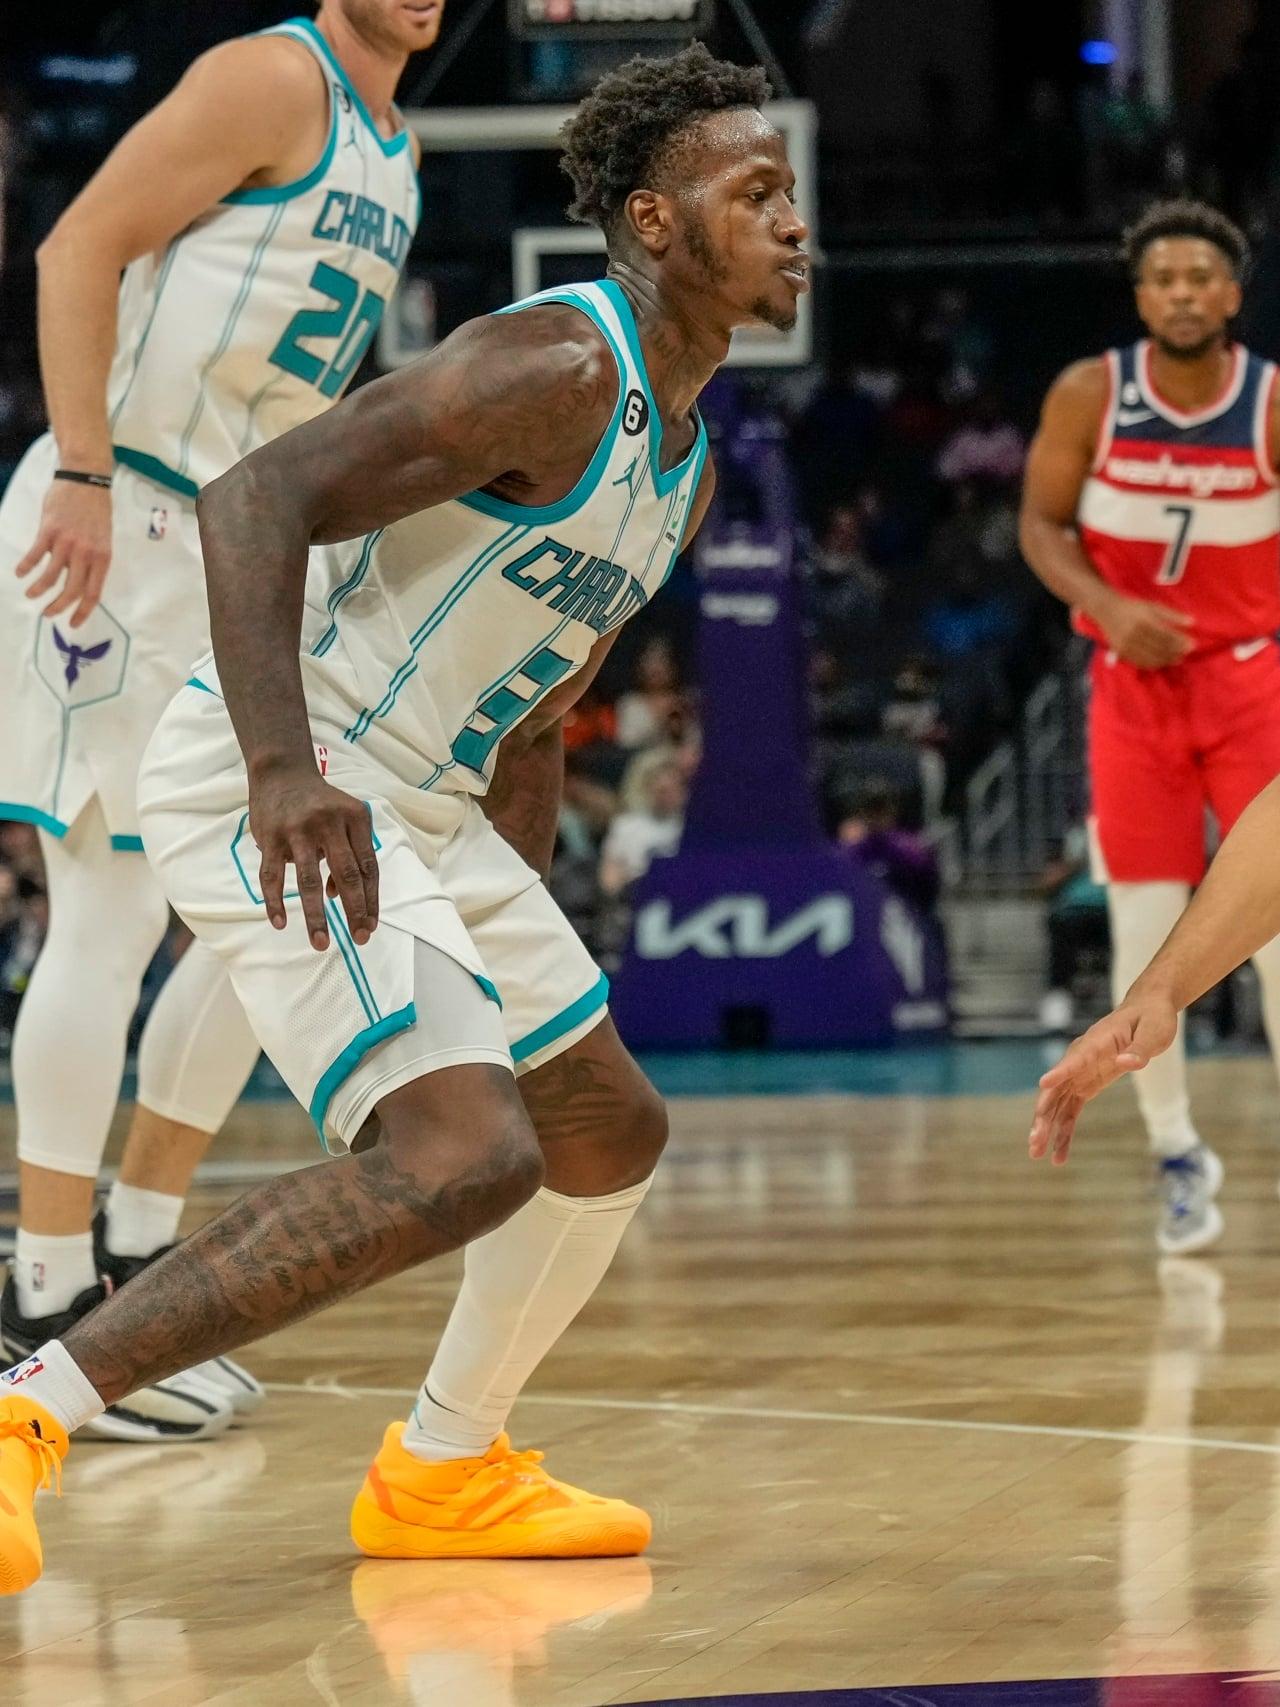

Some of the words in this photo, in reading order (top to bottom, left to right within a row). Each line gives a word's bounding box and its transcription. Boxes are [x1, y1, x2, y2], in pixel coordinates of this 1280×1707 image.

[268, 260, 386, 399] 20
[624, 394, 643, 432] 6
[1156, 503, 1193, 584] 7
